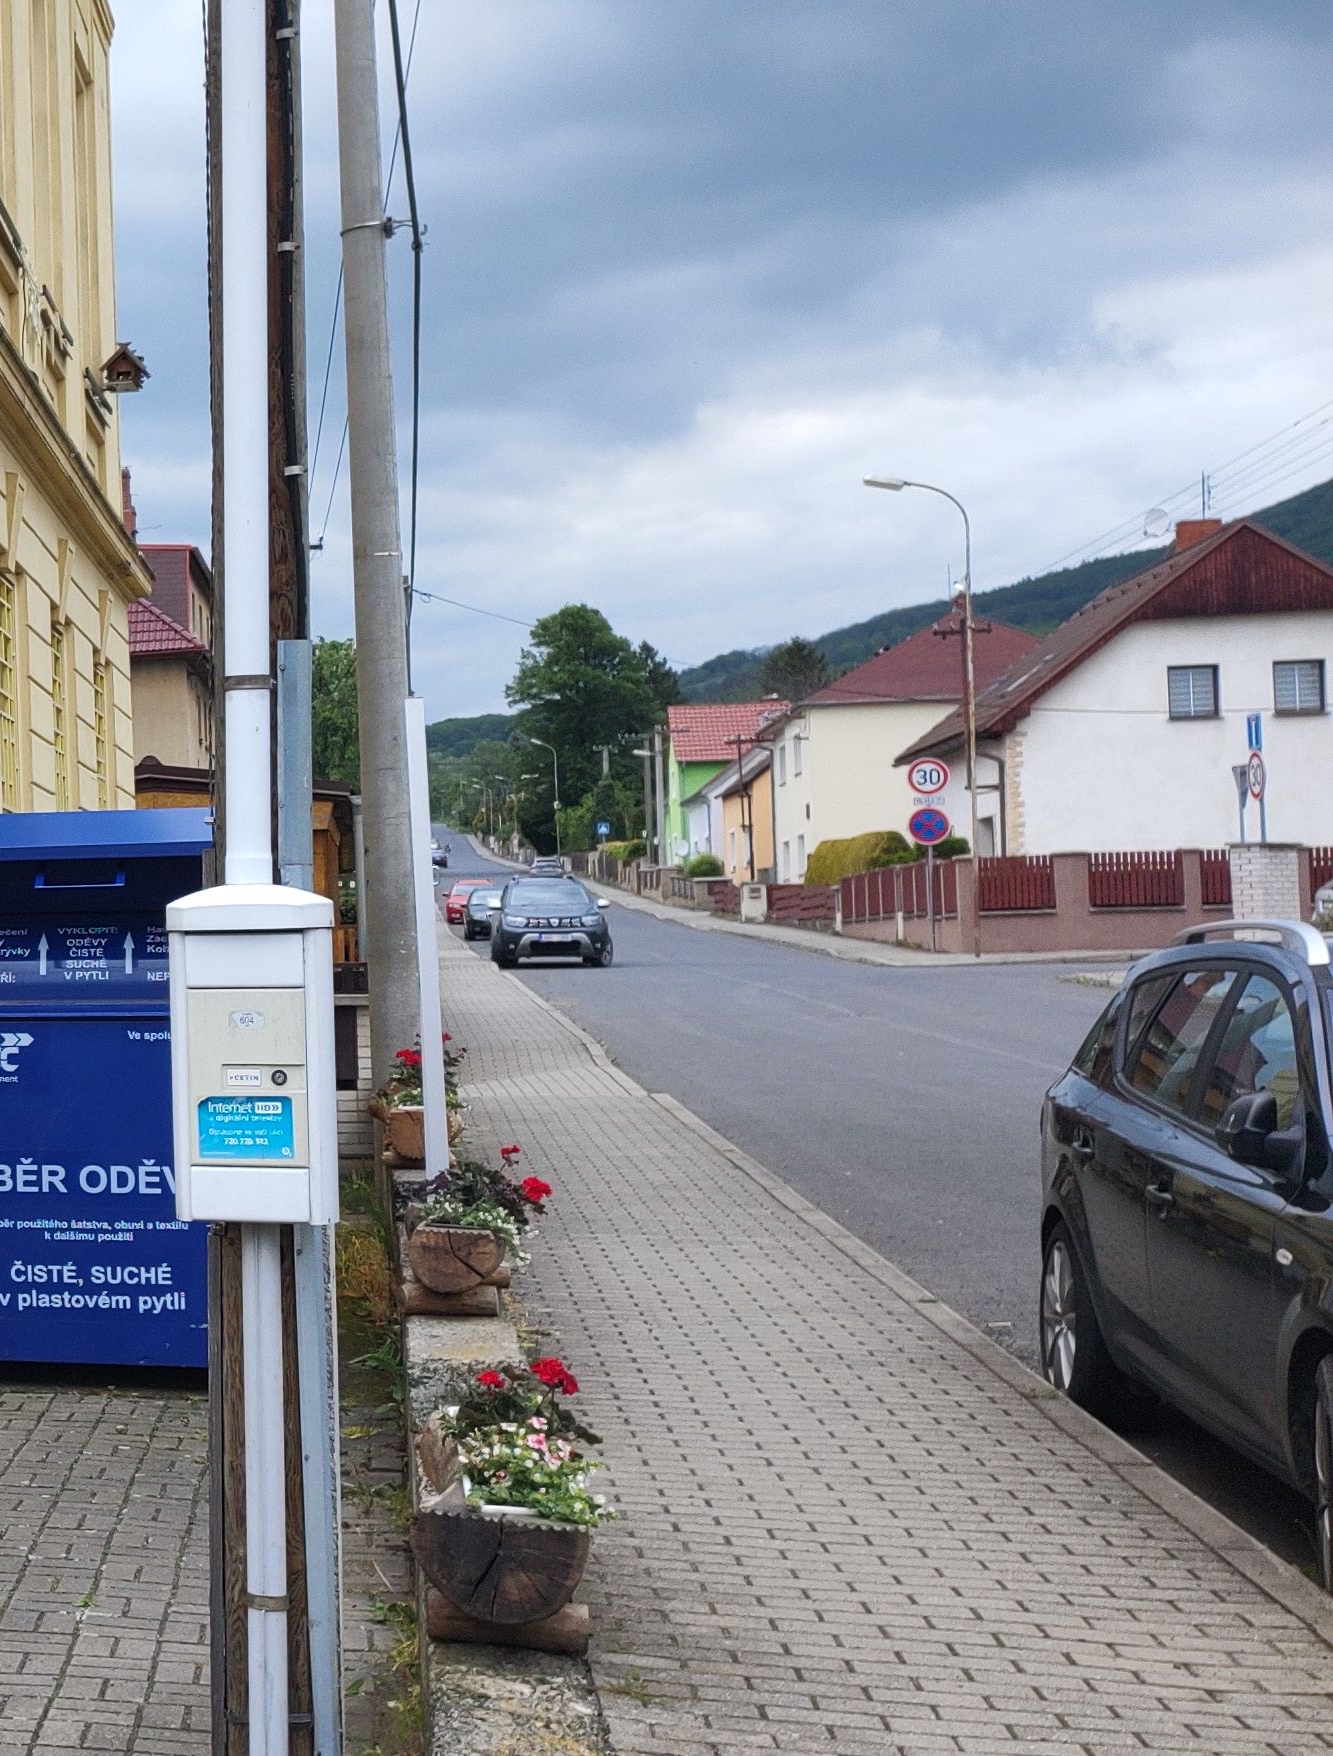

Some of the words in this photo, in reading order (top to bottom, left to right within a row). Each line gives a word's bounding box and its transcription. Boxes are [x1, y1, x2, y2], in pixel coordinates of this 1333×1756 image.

[915, 768, 941, 786] 30
[66, 937, 108, 947] ODĚVY
[65, 958, 108, 969] SUCHÉ
[64, 971, 73, 980] V
[75, 970, 109, 981] PYTLI
[127, 1030, 141, 1040] Ve
[208, 1101, 253, 1114] Internet
[17, 1219, 68, 1230] použitého
[44, 1231, 51, 1241] k
[10, 1260, 83, 1286] ČISTÉ,
[90, 1263, 172, 1285] SUCHÉ
[18, 1289, 131, 1310] plastovém
[138, 1291, 186, 1313] pytli
